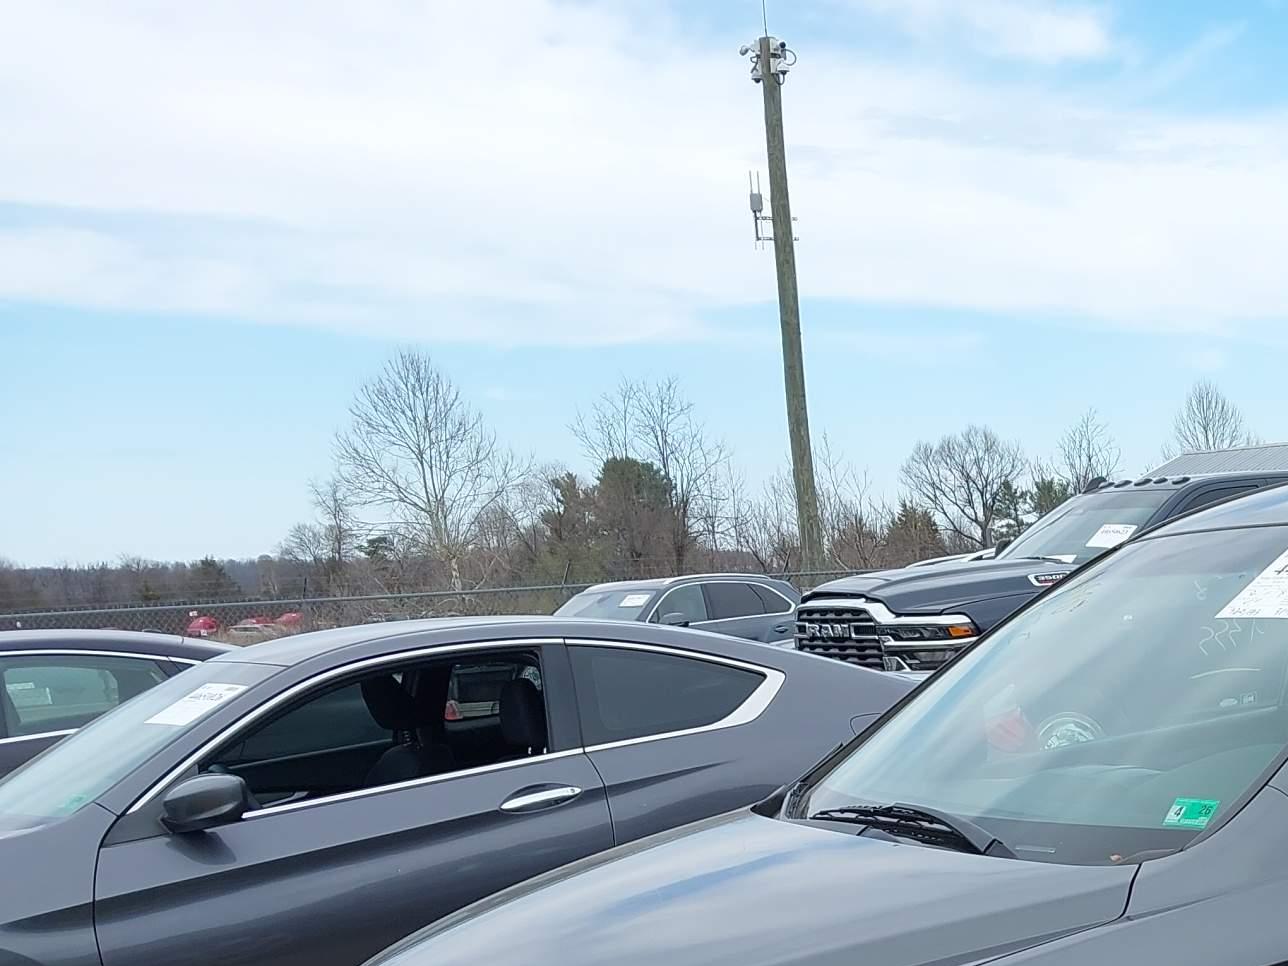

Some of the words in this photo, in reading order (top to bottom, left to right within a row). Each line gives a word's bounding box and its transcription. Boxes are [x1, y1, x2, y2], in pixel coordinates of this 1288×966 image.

[807, 622, 850, 638] RAM
[1174, 806, 1185, 817] 4
[1199, 804, 1213, 815] 26
